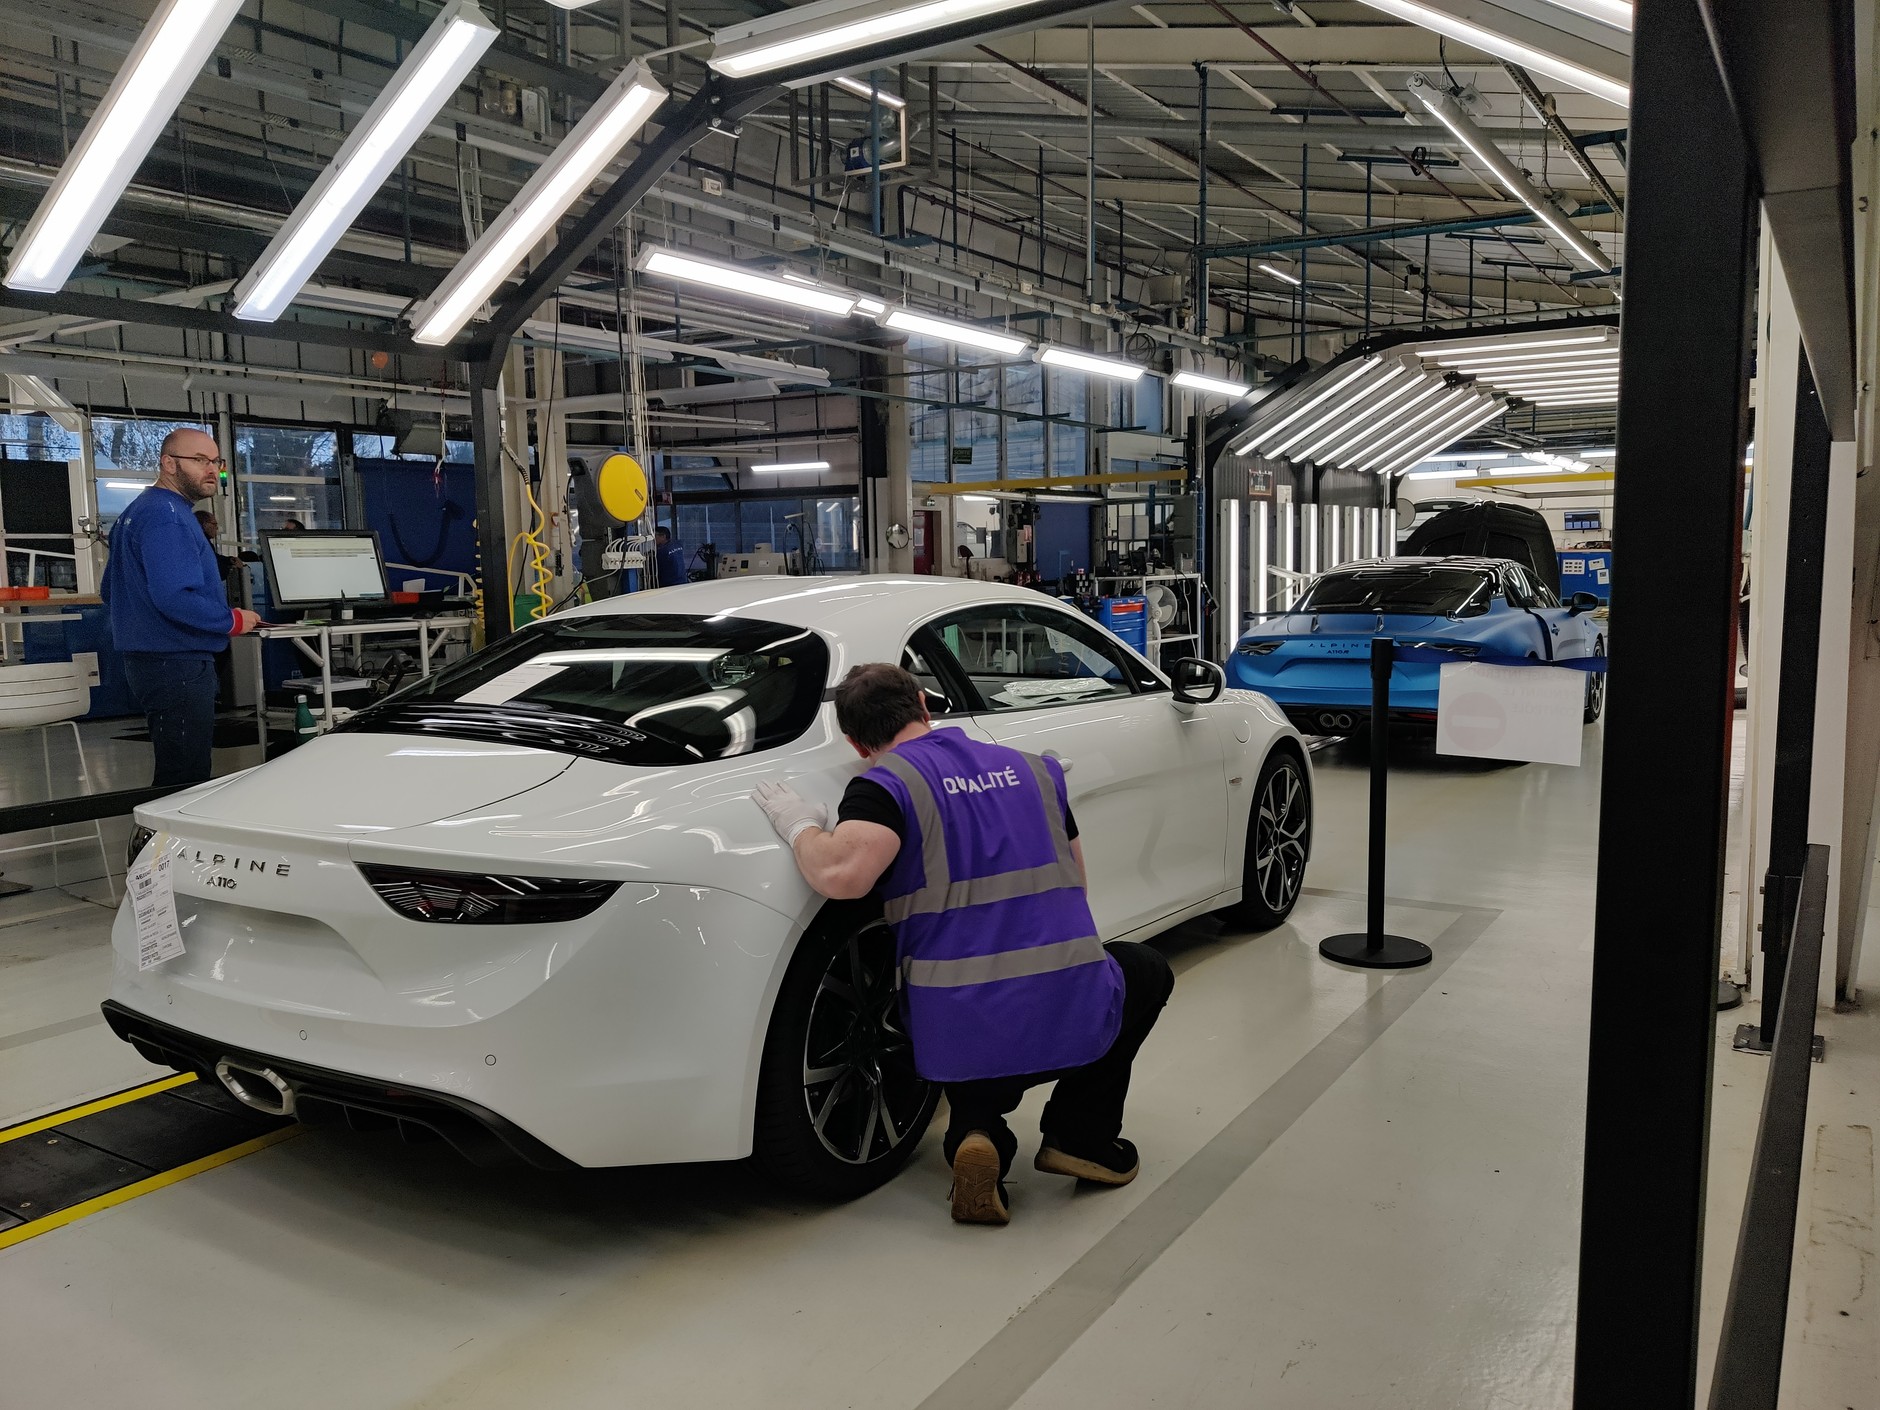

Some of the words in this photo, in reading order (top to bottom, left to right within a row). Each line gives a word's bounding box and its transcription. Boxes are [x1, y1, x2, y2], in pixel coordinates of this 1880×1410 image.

[942, 765, 1020, 794] QUALITÉ
[177, 848, 291, 876] ALPINE
[206, 876, 238, 889] A110
